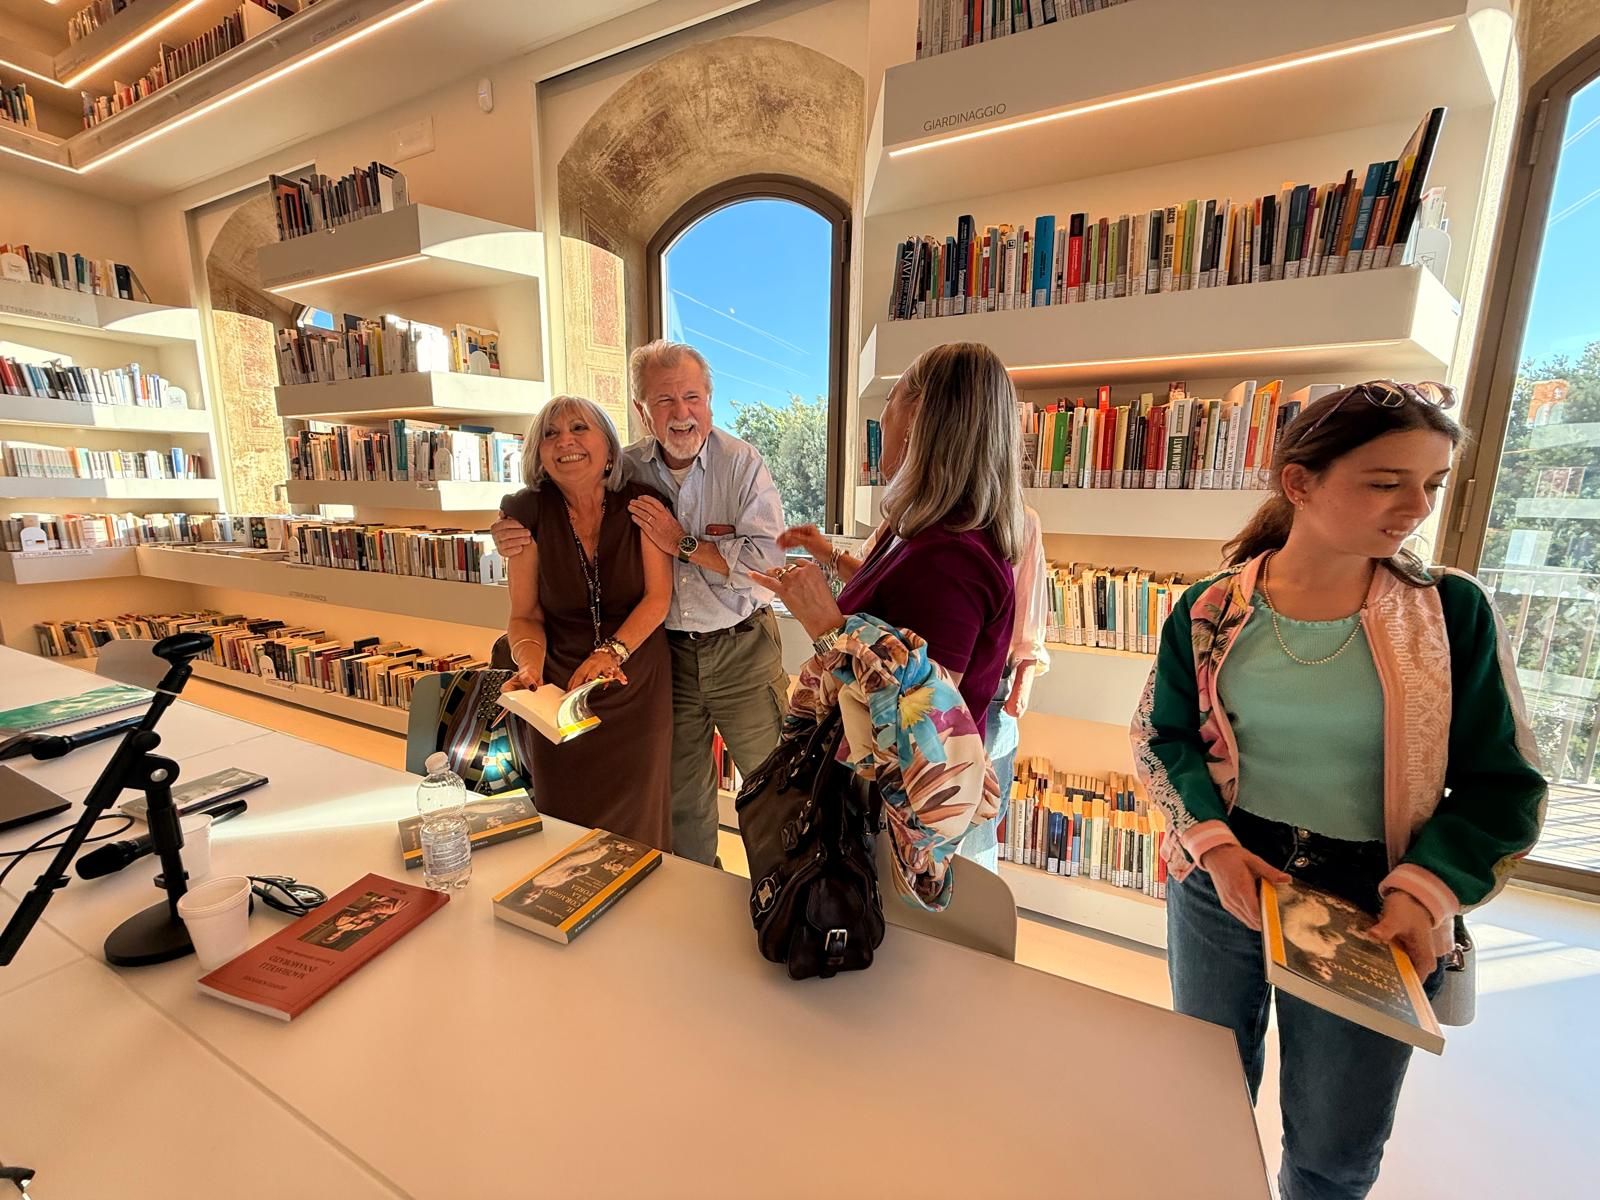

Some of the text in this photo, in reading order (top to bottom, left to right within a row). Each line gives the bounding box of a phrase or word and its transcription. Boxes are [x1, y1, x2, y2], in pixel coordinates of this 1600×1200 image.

[923, 103, 1006, 131] GIARDINAGGIO
[1167, 207, 1176, 224] SACKS
[902, 250, 913, 278] NAVI
[1173, 438, 1183, 454] NATI
[1171, 454, 1181, 471] GANI
[544, 888, 584, 908] CORAGGIO
[569, 884, 594, 898] FORZA
